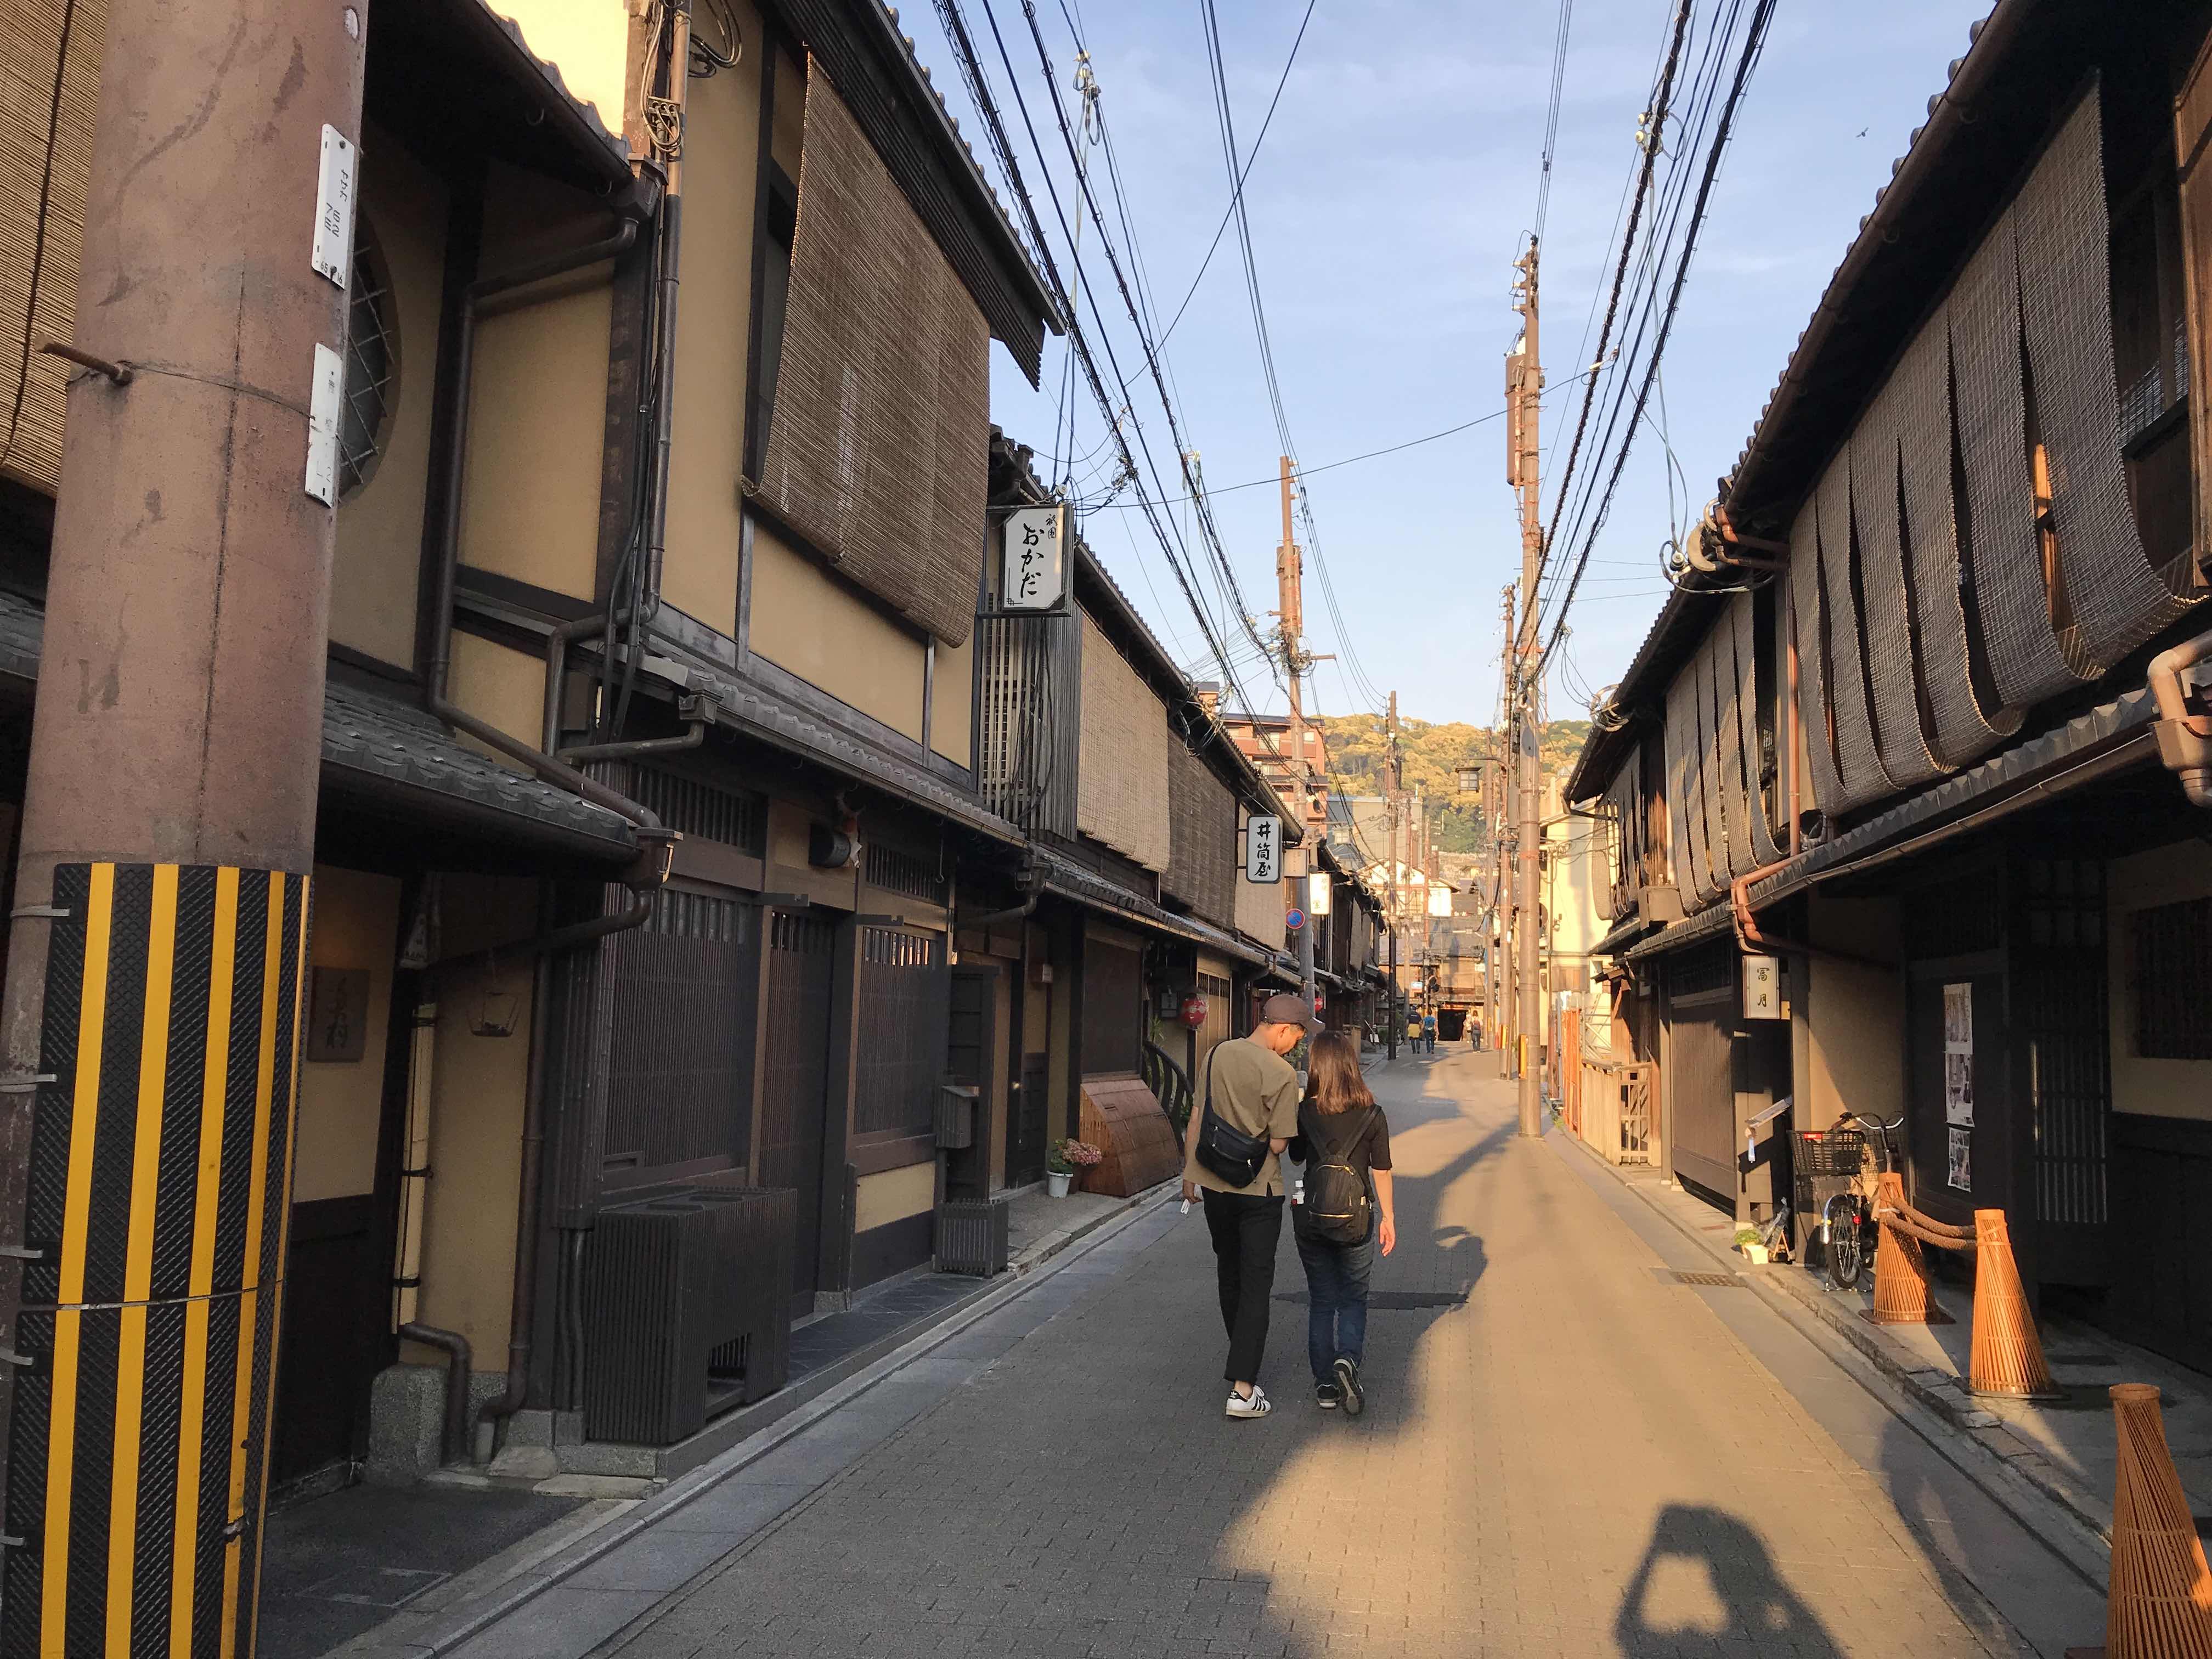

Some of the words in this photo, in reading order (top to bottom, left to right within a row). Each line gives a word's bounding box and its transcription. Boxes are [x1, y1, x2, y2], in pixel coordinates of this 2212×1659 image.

[320, 260, 329, 273] 65
[337, 272, 343, 284] 16
[1020, 522, 1045, 599] おかだ
[1254, 821, 1272, 877] 井筒屋
